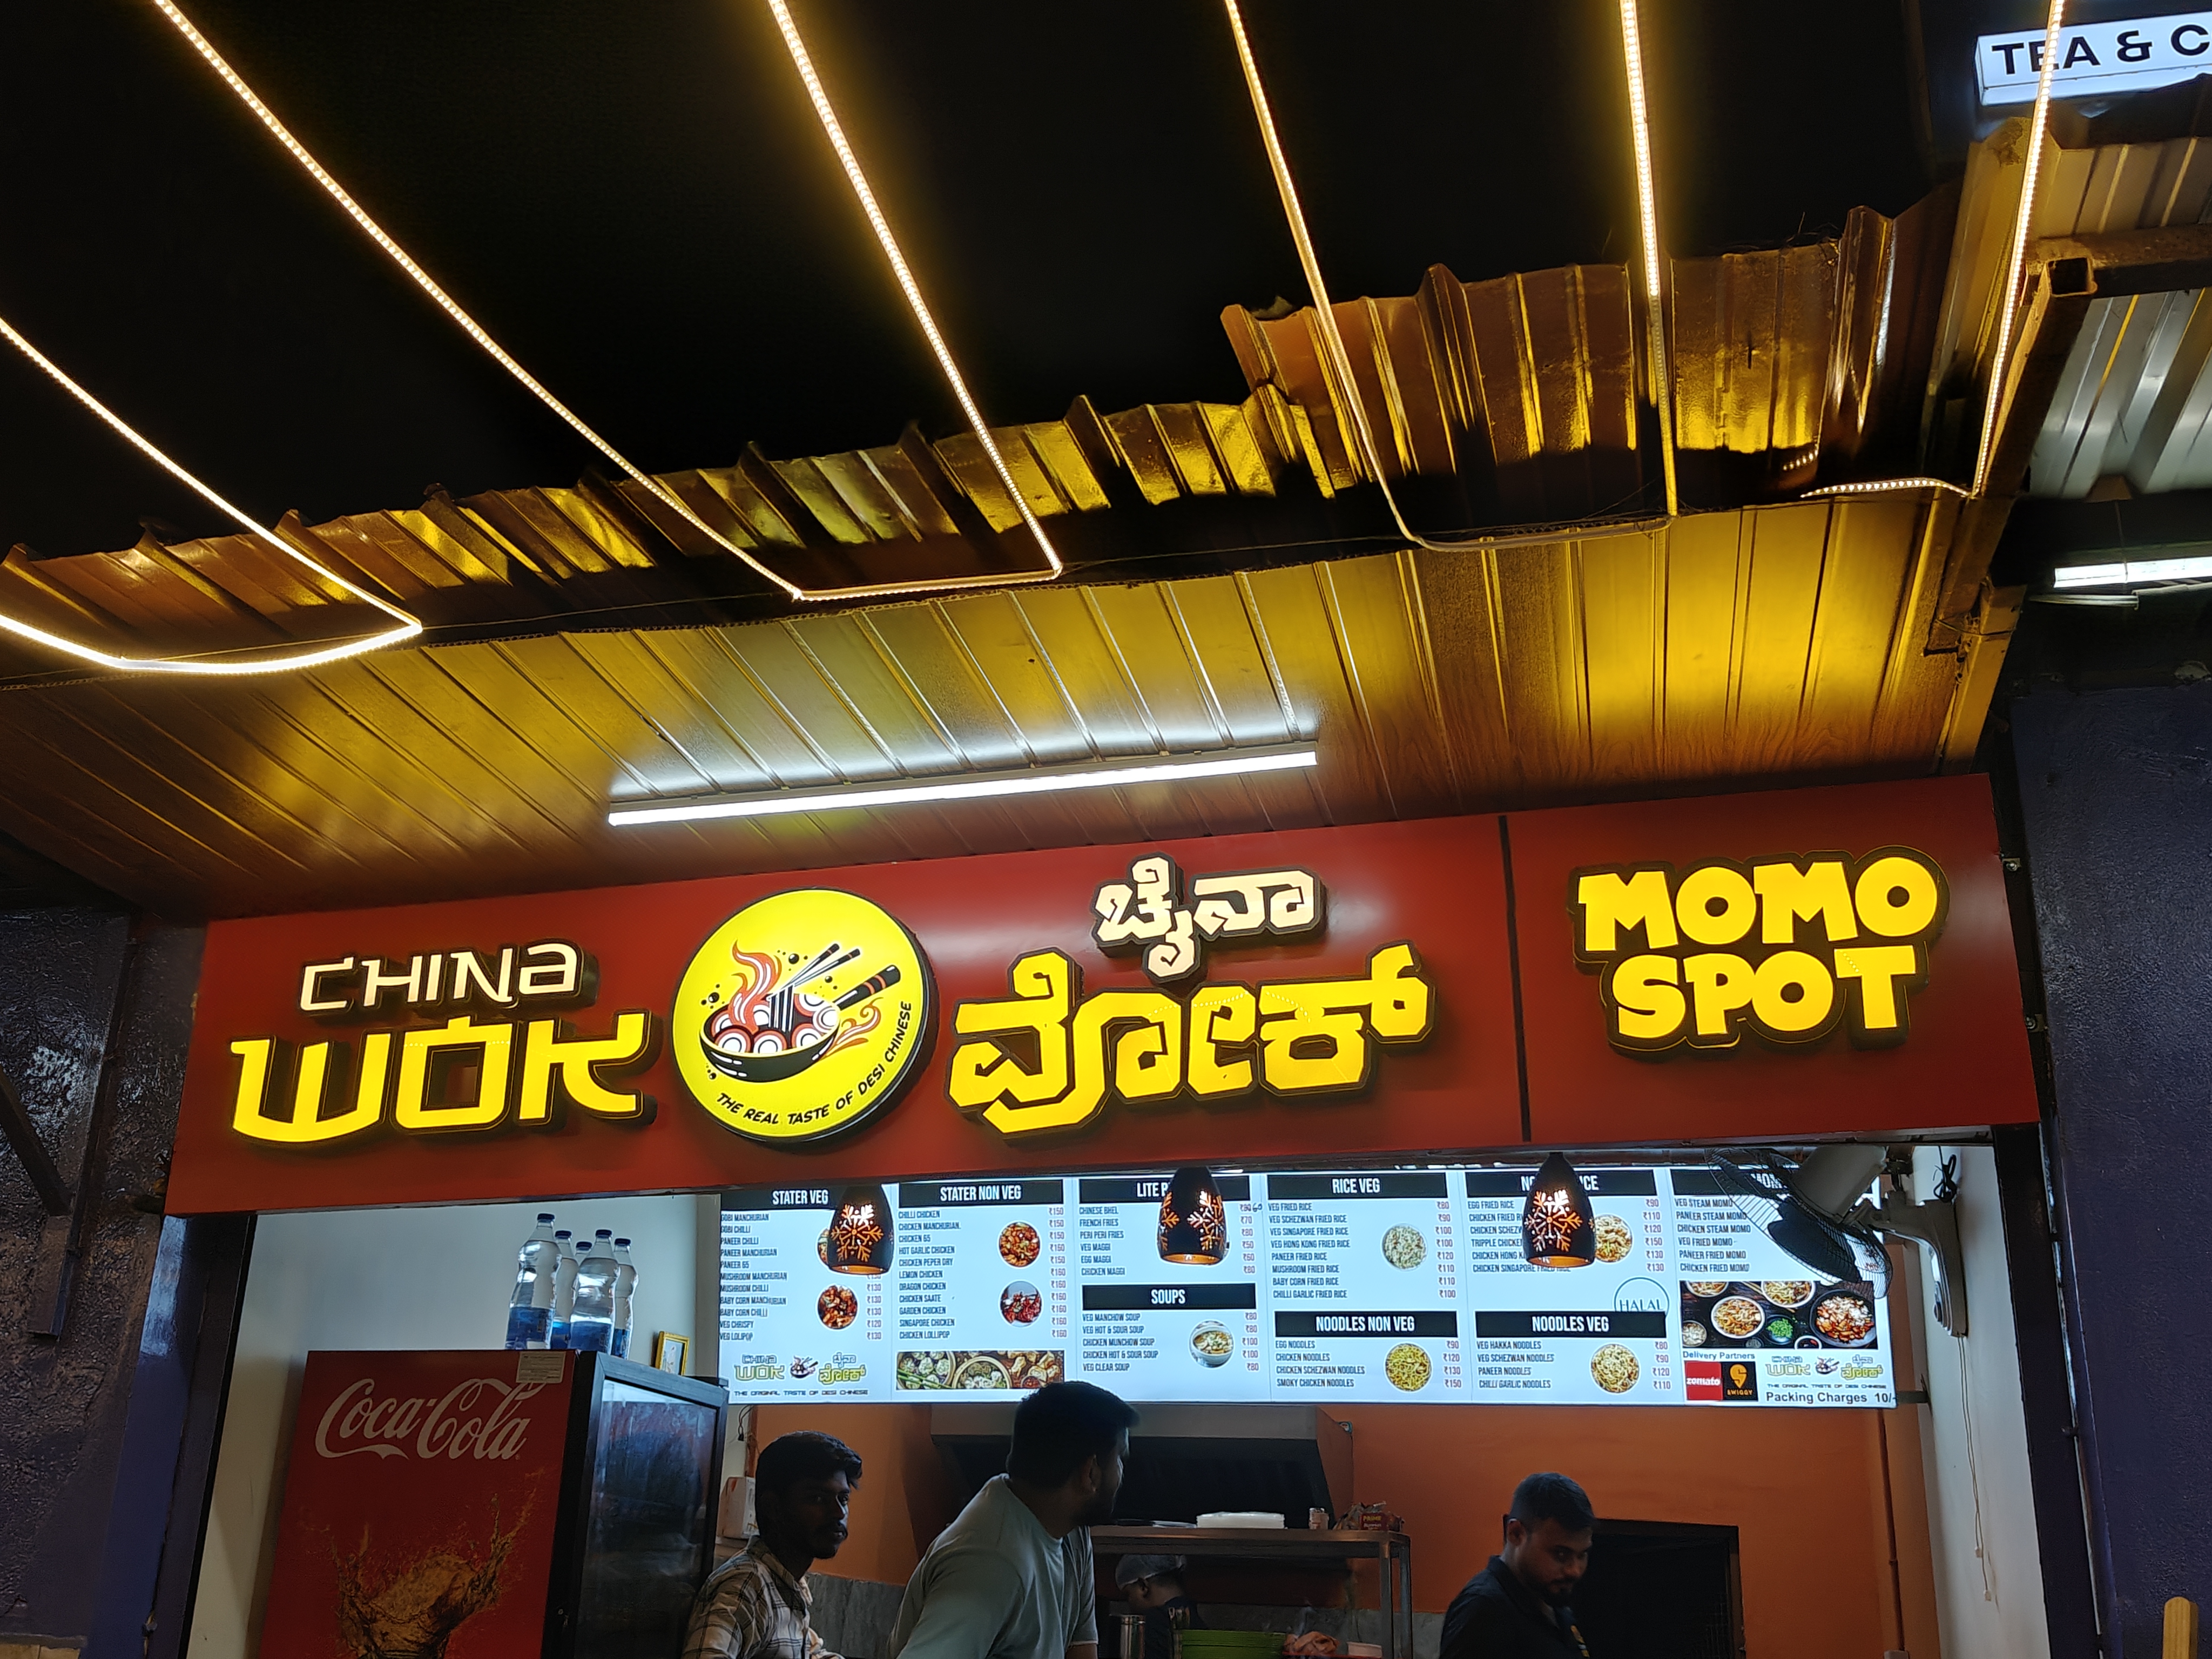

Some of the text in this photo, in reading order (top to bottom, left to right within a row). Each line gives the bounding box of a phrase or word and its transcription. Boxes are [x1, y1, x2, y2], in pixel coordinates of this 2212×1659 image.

[1992, 37, 2101, 75] TEA
[2116, 31, 2152, 62] &
[1578, 857, 1937, 951] MOMO
[1096, 857, 1313, 977] ಚೈನಾ
[1613, 945, 1915, 1038] SPOT
[949, 944, 1428, 1134] ವೋಕ್
[716, 1001, 912, 1125] THE REAL TASTE OF DESI CHINESE
[231, 1013, 645, 1142] WOK
[1137, 1183, 1159, 1197] LITE
[1333, 1178, 1380, 1193] RICE VEG
[773, 1190, 828, 1204] STATER VEG
[940, 1185, 1021, 1201] STATER NON VEG
[1689, 1199, 1711, 1208] STEAM
[1713, 1199, 1733, 1207] MOMO
[1677, 1212, 1701, 1220] PANEER
[1678, 1225, 1705, 1233] CHICKEN
[1678, 1238, 1732, 1246] VEG FRIED MOMO
[1726, 1251, 1746, 1259] MOMO
[1681, 1264, 1749, 1272] CHICKEN FRIED MOMO
[1151, 1290, 1185, 1304] SOUPS
[1273, 1290, 1291, 1298] CHILLI
[1293, 1290, 1314, 1298] GARLIC
[1316, 1290, 1332, 1298] FRIED
[1620, 1299, 1663, 1311] HALAL
[1316, 1317, 1414, 1331] NOODLES NON VEG
[1533, 1317, 1609, 1332] NOODLES VEG
[1683, 1351, 1716, 1360] Delivery
[1687, 1377, 1721, 1385] zomato
[1766, 1392, 1813, 1404] Packing
[1818, 1393, 1867, 1404] Charges
[315, 1378, 546, 1460] Coca-Cola
